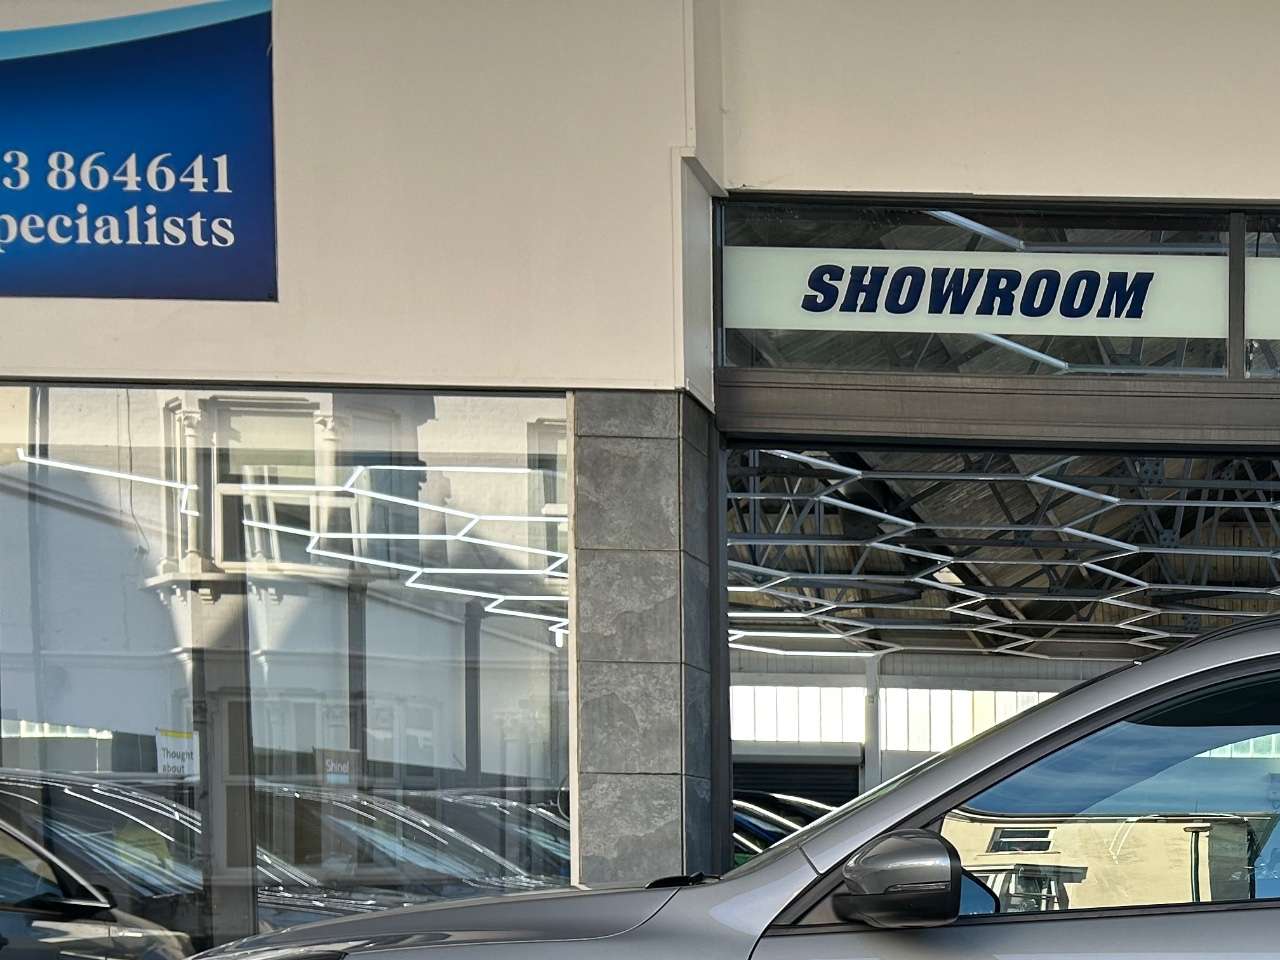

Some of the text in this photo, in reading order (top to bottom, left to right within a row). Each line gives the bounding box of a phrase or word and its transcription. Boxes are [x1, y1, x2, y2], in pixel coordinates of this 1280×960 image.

[47, 151, 232, 193] 864641
[801, 263, 1155, 320] SHOWROOM
[161, 747, 194, 763] Thought
[162, 763, 185, 774] about
